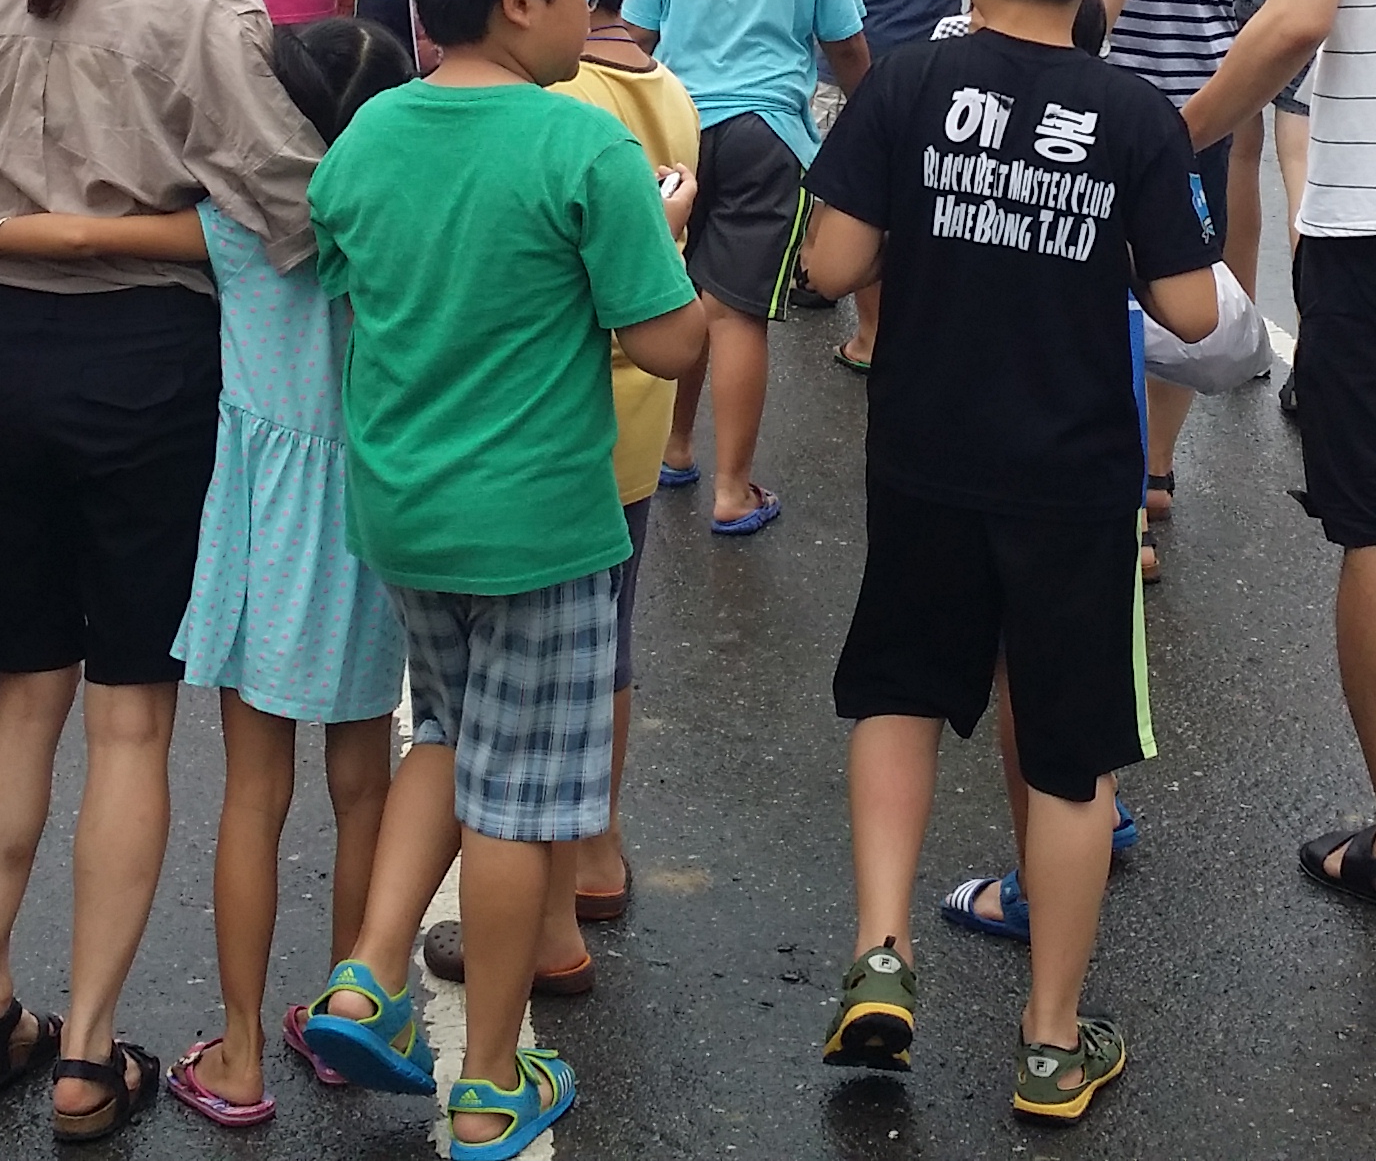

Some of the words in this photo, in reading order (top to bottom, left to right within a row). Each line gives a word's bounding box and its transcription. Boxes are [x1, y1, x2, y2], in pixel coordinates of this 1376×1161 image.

[1007, 158, 1072, 211] MASTER
[1070, 172, 1117, 219] CLUB
[1037, 208, 1097, 262] T.K.D
